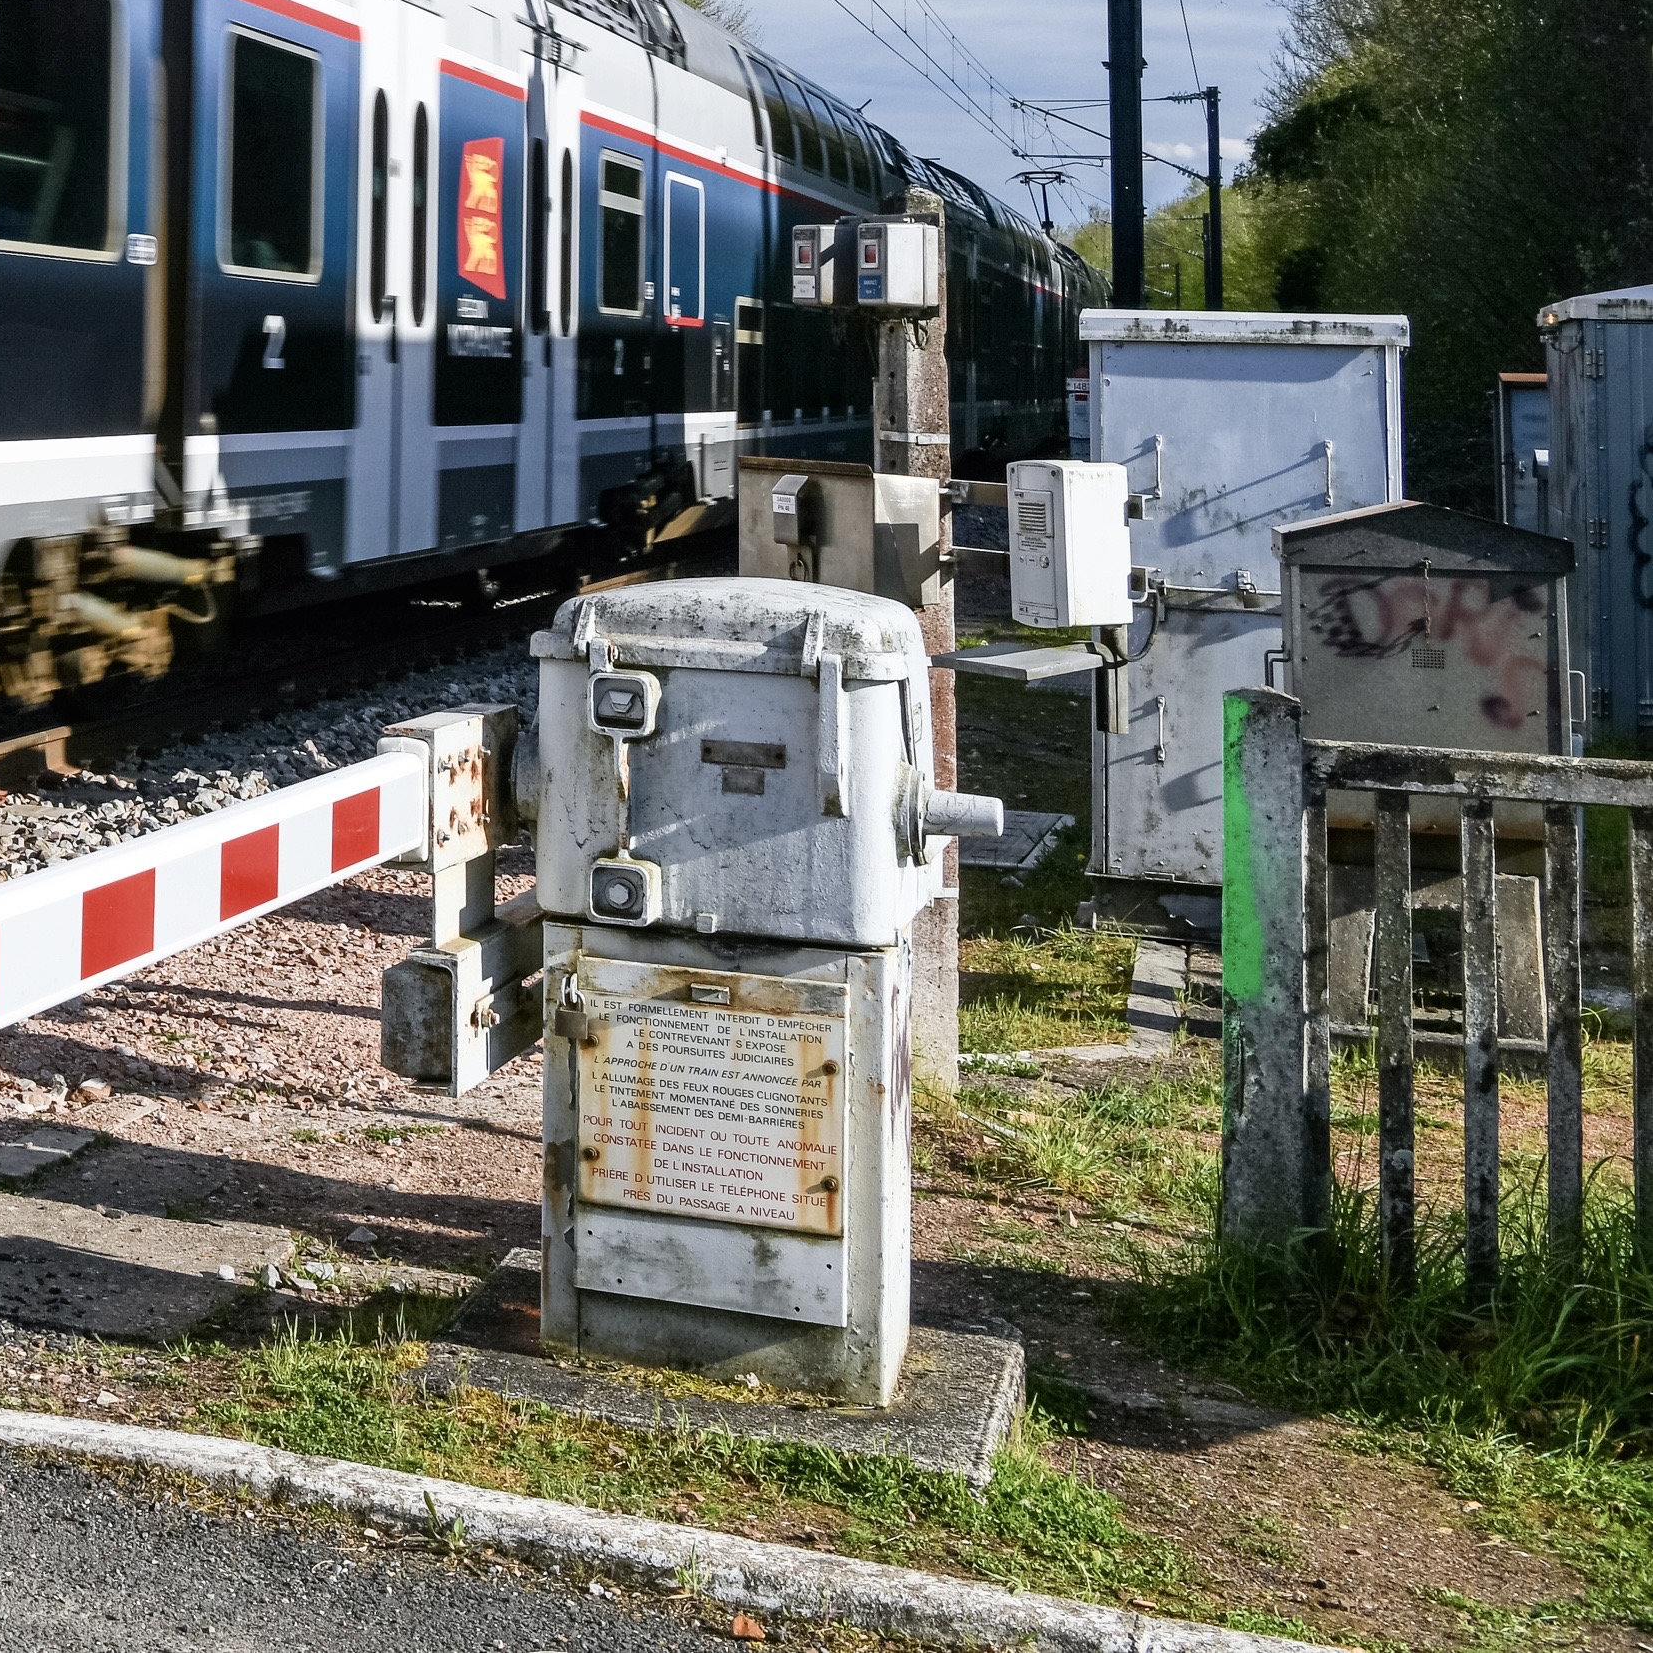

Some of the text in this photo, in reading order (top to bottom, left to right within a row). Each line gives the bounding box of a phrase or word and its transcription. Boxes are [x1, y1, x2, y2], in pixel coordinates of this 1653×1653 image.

[262, 314, 286, 369] 2
[590, 1000, 598, 1008] IL
[604, 1001, 622, 1010] EST
[628, 1004, 708, 1019] FORMELLEMENT
[716, 1012, 760, 1024] INTERDIT
[599, 1013, 610, 1022] LE
[616, 1015, 709, 1032] FONCTIONNEMENT
[718, 1026, 730, 1034] DE
[634, 1028, 644, 1037] LE
[649, 1030, 730, 1047] CONTREVENANT
[638, 1042, 658, 1052] DES
[662, 1044, 725, 1059] POURSUITES
[730, 1052, 794, 1066] JUDICIAIRES
[688, 1066, 718, 1078] TRAIN
[721, 1070, 740, 1079] EST
[742, 1073, 798, 1086] ANNONCÉE
[802, 1079, 822, 1088] PAR
[594, 1084, 824, 1119] LE TINTEMENT MOMENTANÉ DES SONNERIES
[660, 1080, 679, 1089] DES
[684, 1082, 708, 1093] FEUX
[712, 1085, 754, 1098] ROUGES
[756, 1090, 828, 1106] CLIGNOTANTS
[694, 1109, 714, 1119] DES
[584, 1115, 838, 1155] POUR TOUT INCIDENT OU TOUTE ANOMALIE
[654, 1158, 669, 1168] DE
[662, 1142, 694, 1155] DANS
[700, 1147, 712, 1158] LE
[718, 1149, 826, 1171] FONCTIONNEMENT
[702, 1182, 714, 1192] LE
[656, 1194, 674, 1204] DU
[680, 1197, 730, 1213] PASSAGE
[736, 1205, 744, 1214] A
[750, 1207, 795, 1221] NIVEAU
